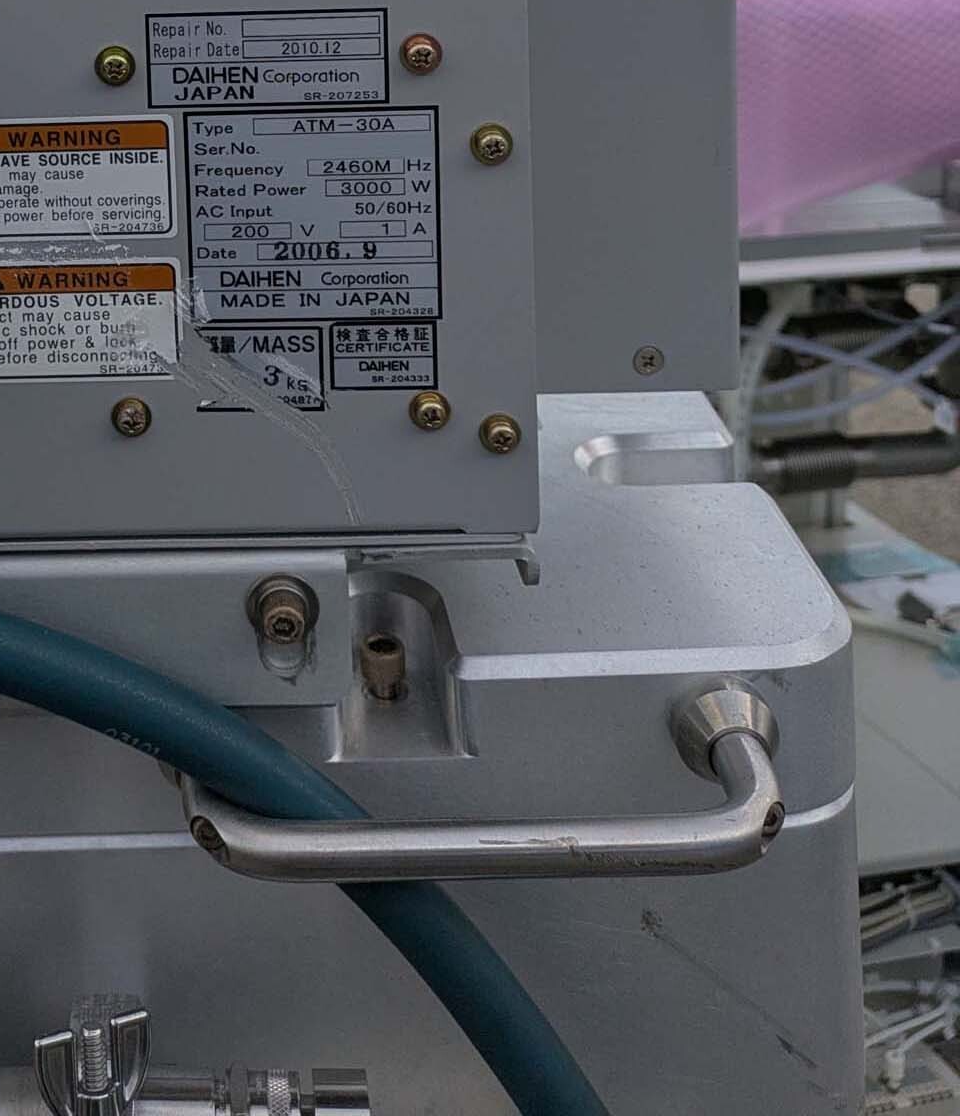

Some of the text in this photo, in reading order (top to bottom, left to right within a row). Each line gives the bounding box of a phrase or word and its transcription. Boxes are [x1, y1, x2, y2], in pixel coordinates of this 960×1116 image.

[152, 21, 226, 38] Repair No.
[153, 41, 341, 59] Repair Date 2010.12
[172, 66, 360, 86] DAIHEN Corporation
[174, 85, 379, 101] JAPAN SR-207253
[192, 117, 395, 137] Type ATM-30A
[8, 129, 121, 148] WARNING
[38, 152, 101, 167] SOURCE
[110, 151, 164, 165] INSIDE.
[9, 171, 37, 184] may
[44, 168, 84, 181] cause
[194, 159, 432, 179] Frequency 2460M Hz
[195, 180, 431, 198] Rated Power 3000 W
[45, 195, 93, 208] without
[96, 193, 166, 208] coverings.
[3, 211, 44, 225] power
[51, 208, 95, 222] before
[102, 207, 166, 222] servicing.
[195, 201, 432, 220] AC Input 50/60Hz
[231, 222, 427, 238] 200 V 1 A
[197, 246, 237, 260] Date
[16, 272, 129, 290] WARNING
[220, 270, 409, 288] DAIHEN Corporation
[74, 292, 163, 307] VOLTAGE.
[221, 291, 410, 308] MADE IN JAPAN
[22, 312, 54, 327] may
[64, 310, 110, 322] cause
[20, 322, 66, 337] shock
[74, 325, 90, 336] or
[27, 338, 75, 353] power
[84, 337, 95, 349] &
[336, 342, 430, 353] CERTIFICATE
[359, 361, 409, 372] DAIHEN
